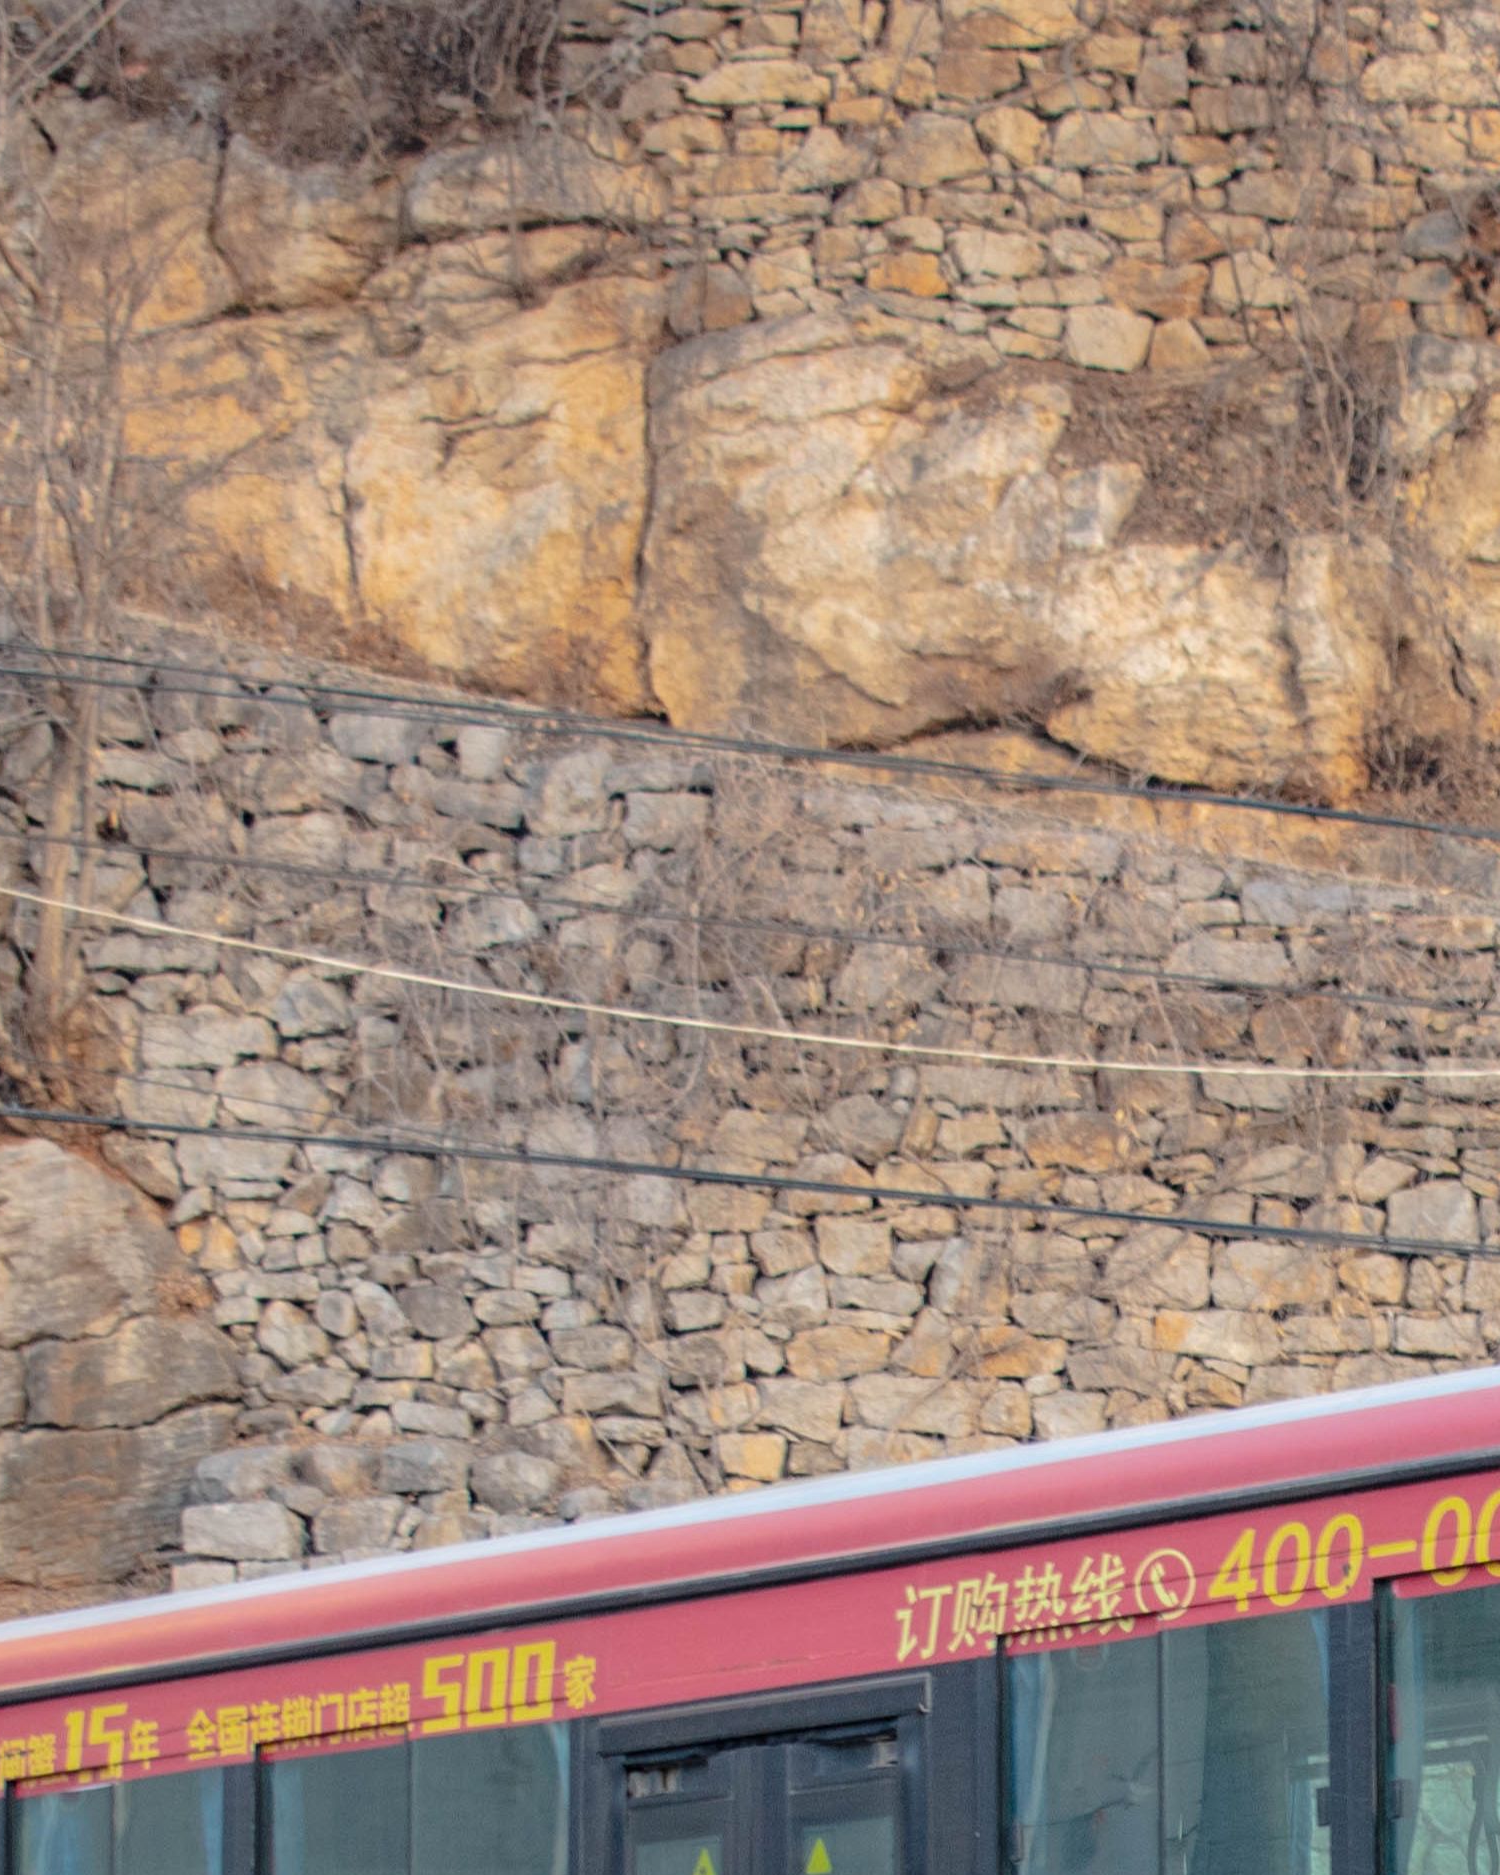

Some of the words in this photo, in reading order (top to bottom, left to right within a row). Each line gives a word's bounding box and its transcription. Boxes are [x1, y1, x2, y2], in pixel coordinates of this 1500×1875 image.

[897, 1552, 1136, 1662] 订购热线
[186, 1640, 598, 1758] 全国连锁门店超500家
